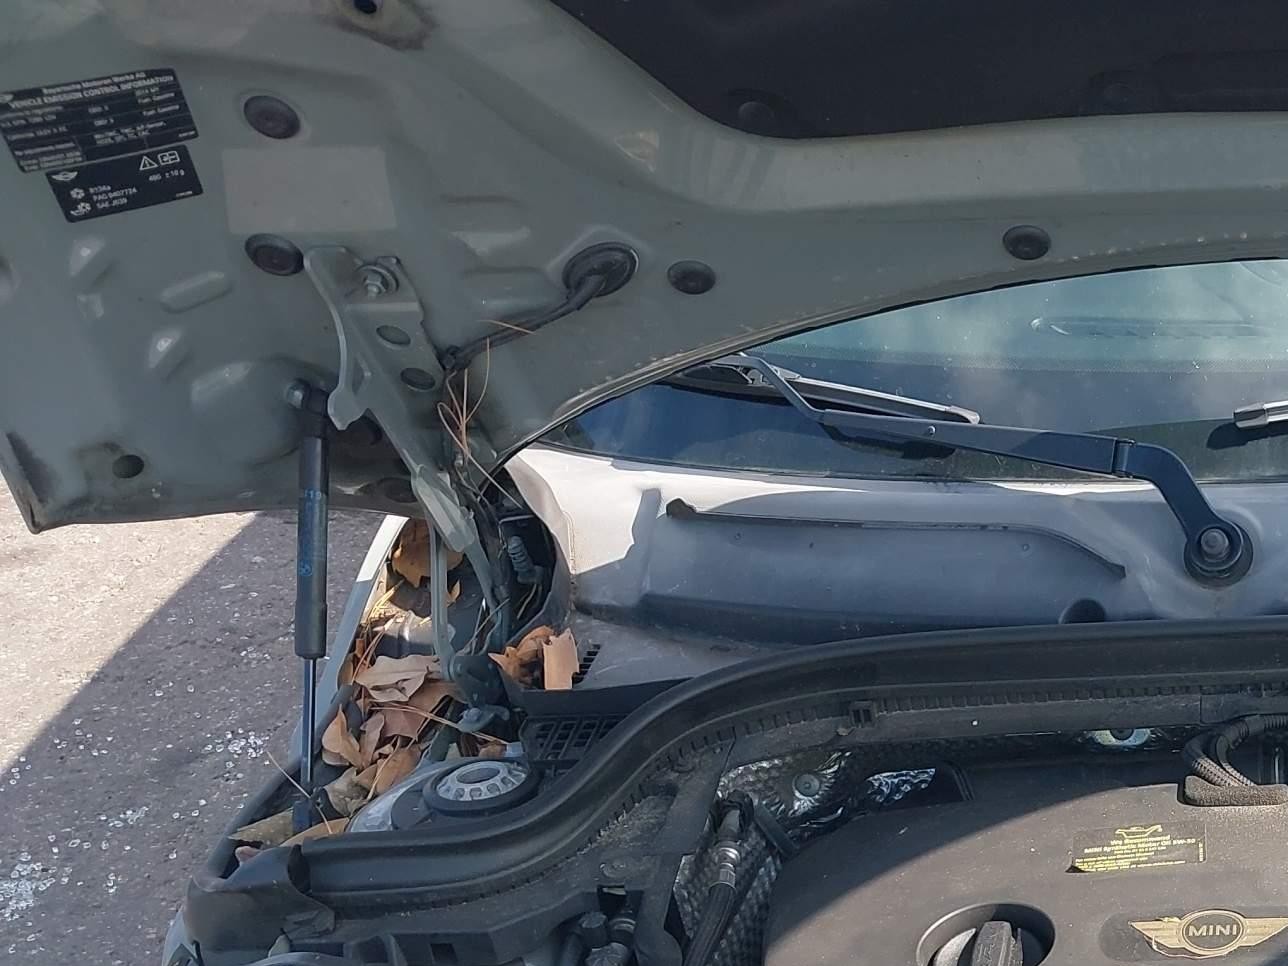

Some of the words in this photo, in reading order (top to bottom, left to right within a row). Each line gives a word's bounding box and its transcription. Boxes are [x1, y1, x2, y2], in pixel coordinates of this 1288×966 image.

[8, 97, 43, 109] VEHICLE
[43, 92, 83, 104] EMISSION
[83, 85, 120, 97] CONTROL
[120, 76, 174, 91] INFORMATION
[1084, 846, 1102, 854] MINI
[1188, 923, 1238, 937] MINI
